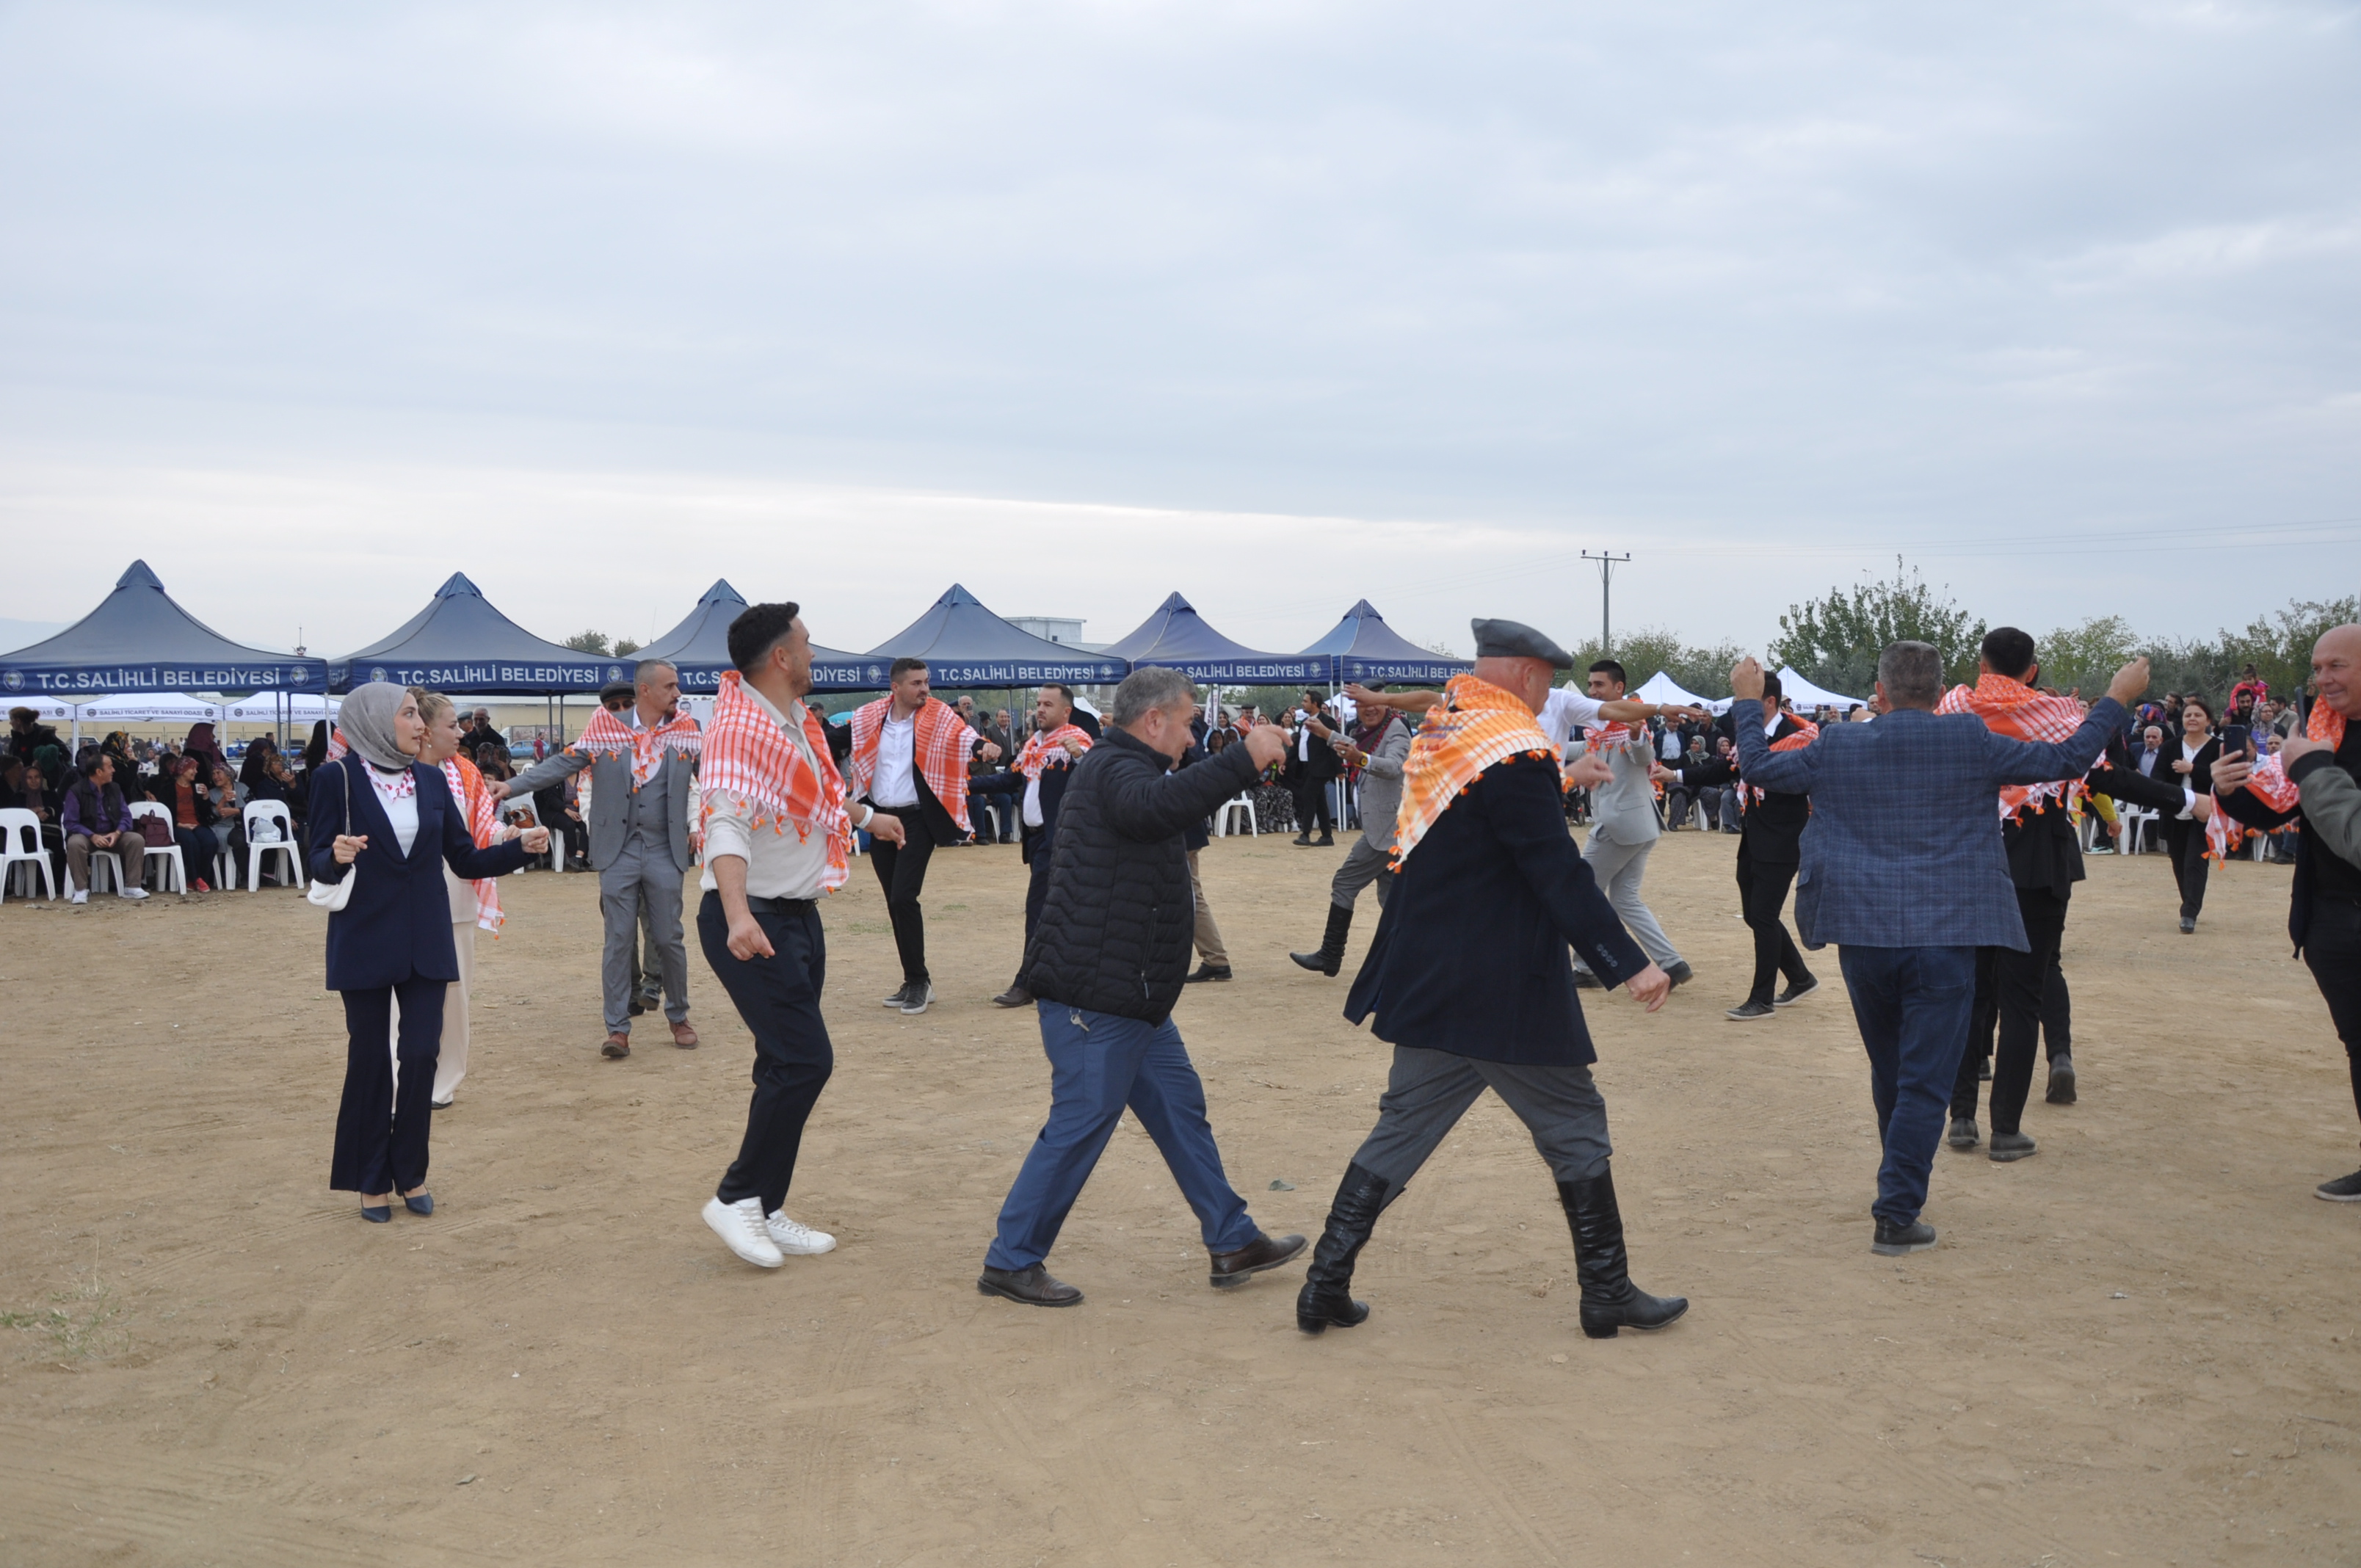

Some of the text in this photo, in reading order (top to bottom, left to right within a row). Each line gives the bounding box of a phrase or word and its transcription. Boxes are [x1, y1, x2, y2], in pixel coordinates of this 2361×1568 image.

[37, 667, 280, 689] T.C.SALİHLİ BELEDİYESİ
[397, 664, 598, 685] T.C.SALİHLİ BELEDİYESİ
[808, 666, 860, 682] DİYESİ
[938, 664, 1095, 681] T.C.SALİHLİ BELEDİYESİ
[1236, 664, 1305, 678] BELEDİYESİ
